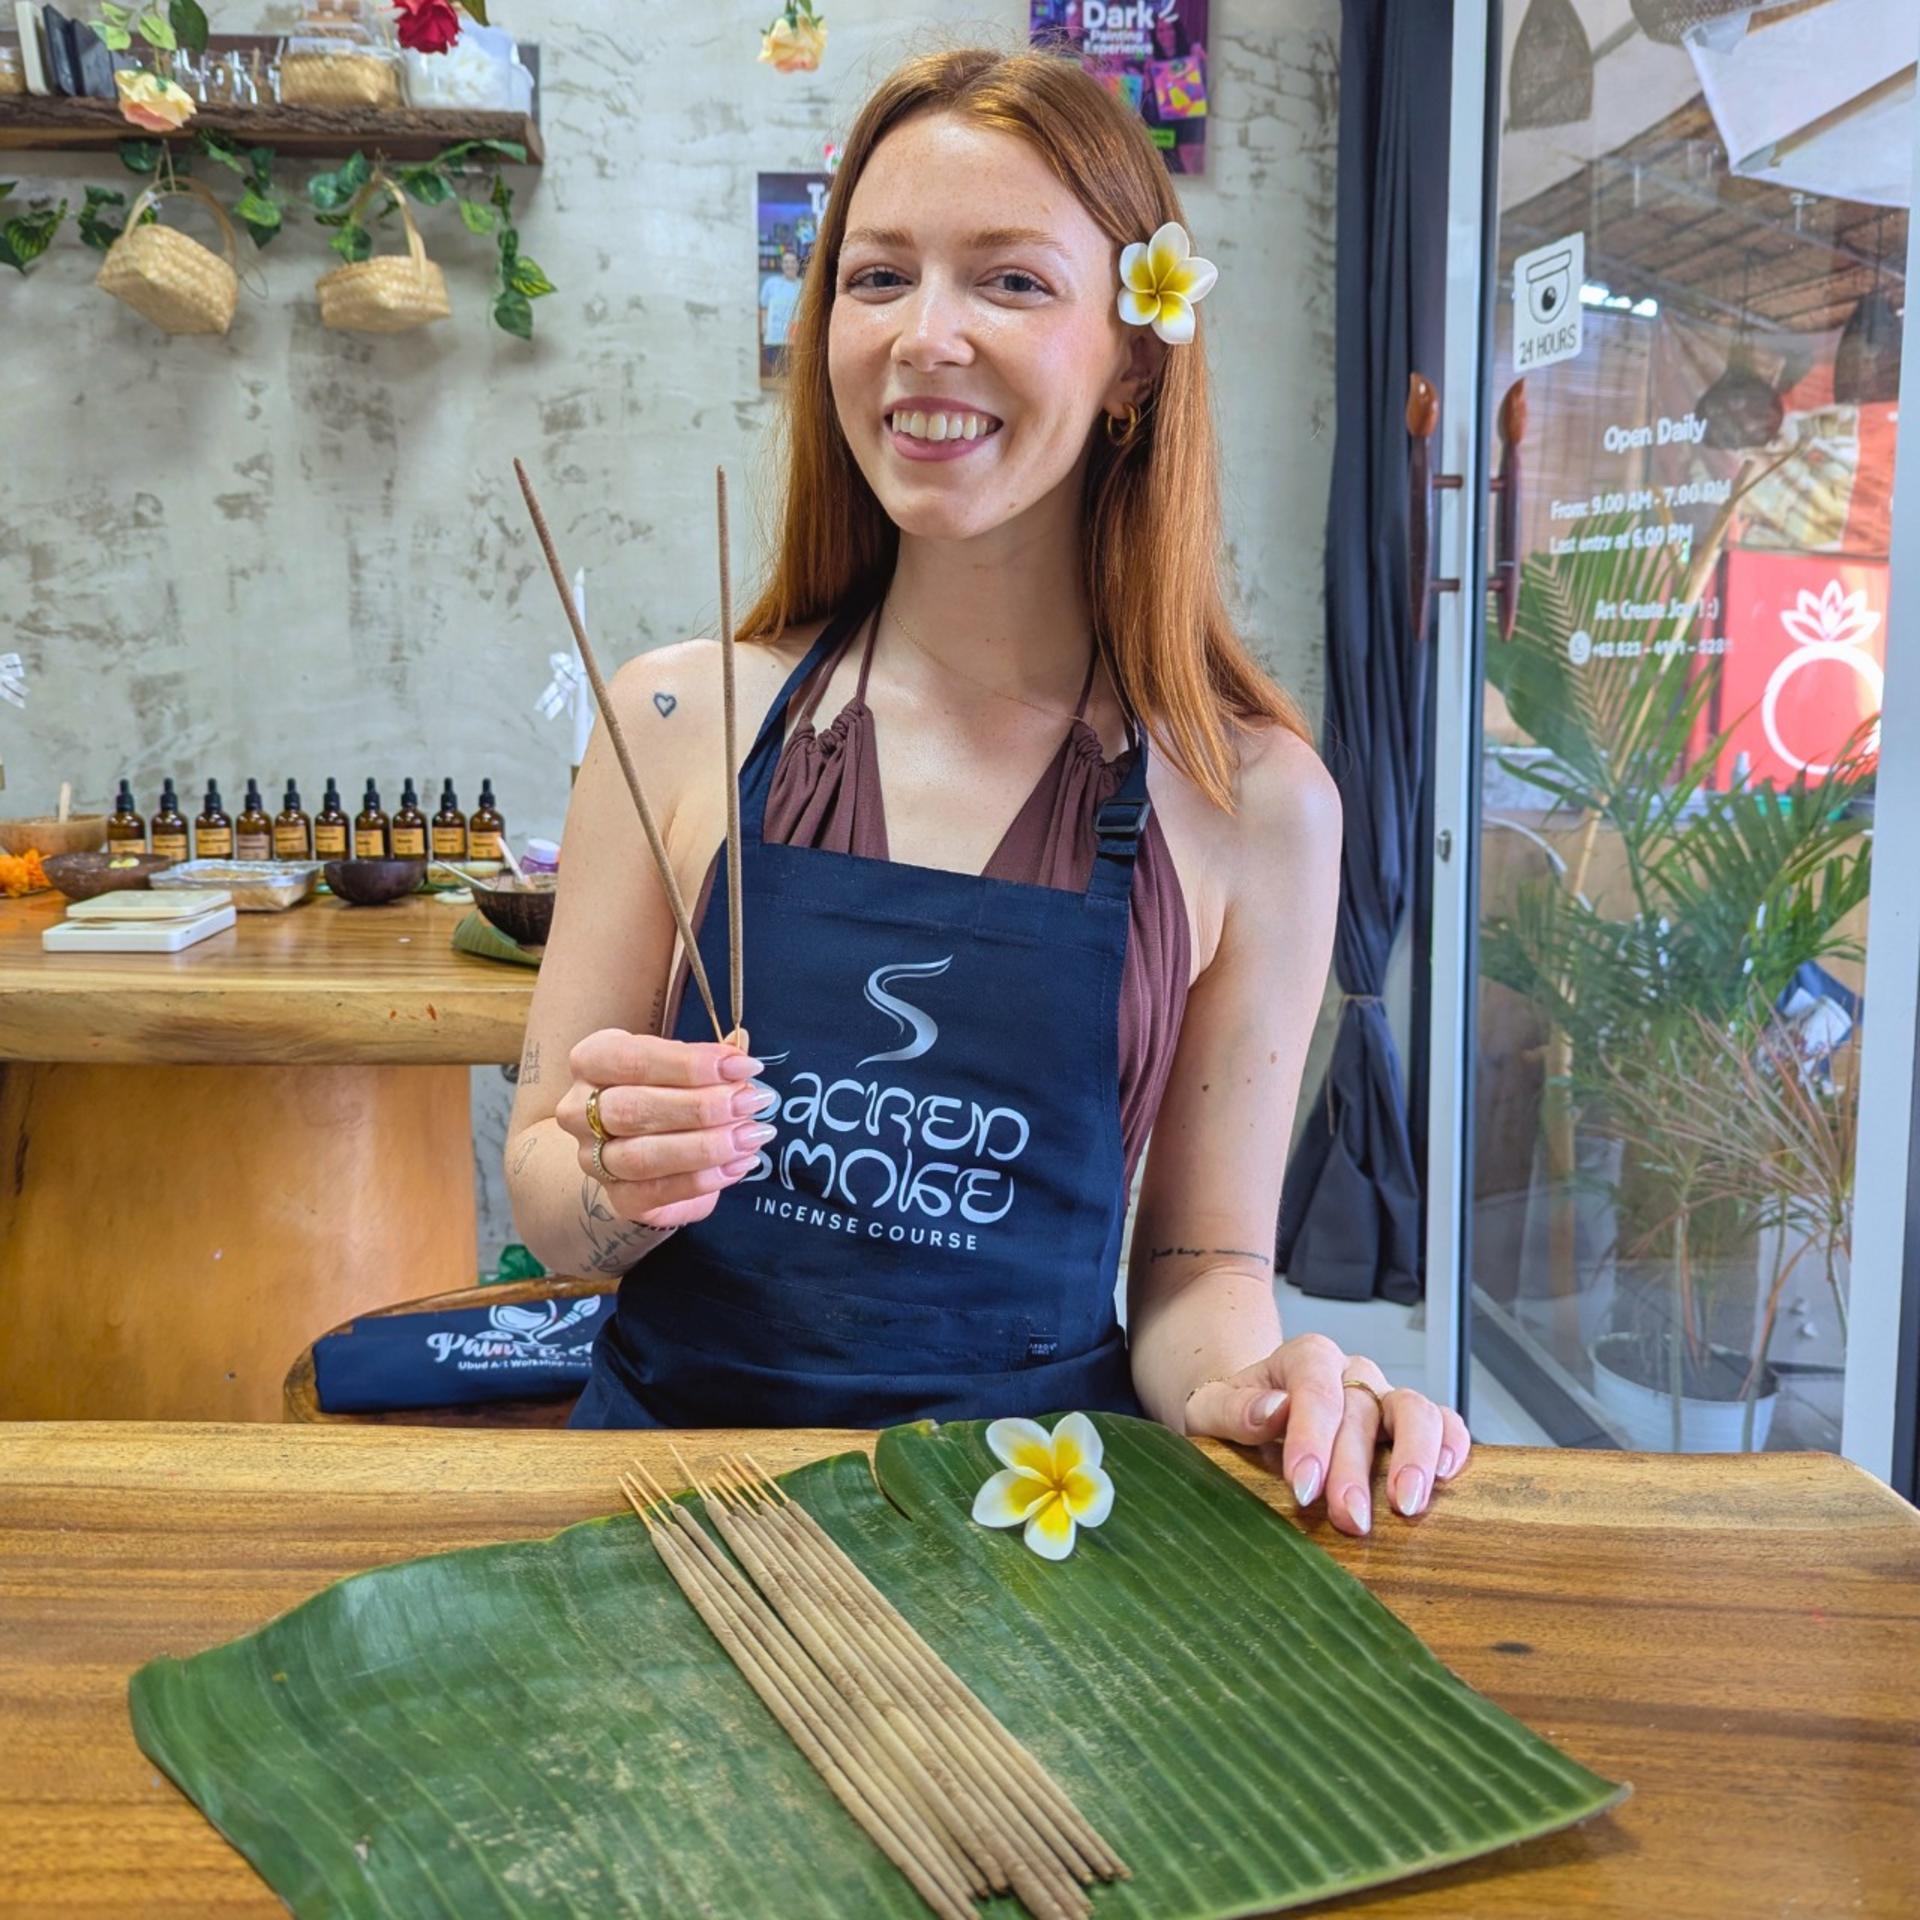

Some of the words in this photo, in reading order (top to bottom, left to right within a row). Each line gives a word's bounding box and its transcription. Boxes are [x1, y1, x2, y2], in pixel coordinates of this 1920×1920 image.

[1083, 0, 1155, 29] Dark
[1519, 339, 1533, 365] 24
[1536, 323, 1577, 358] HOURS
[1603, 425, 1653, 454] Open
[1657, 412, 1707, 445] Daily
[1663, 482, 1698, 508] 7.00
[1667, 522, 1693, 545] PM
[755, 1196, 859, 1234] INCENSE
[868, 1222, 977, 1250] COURSE
[457, 1360, 488, 1370] Ubud
